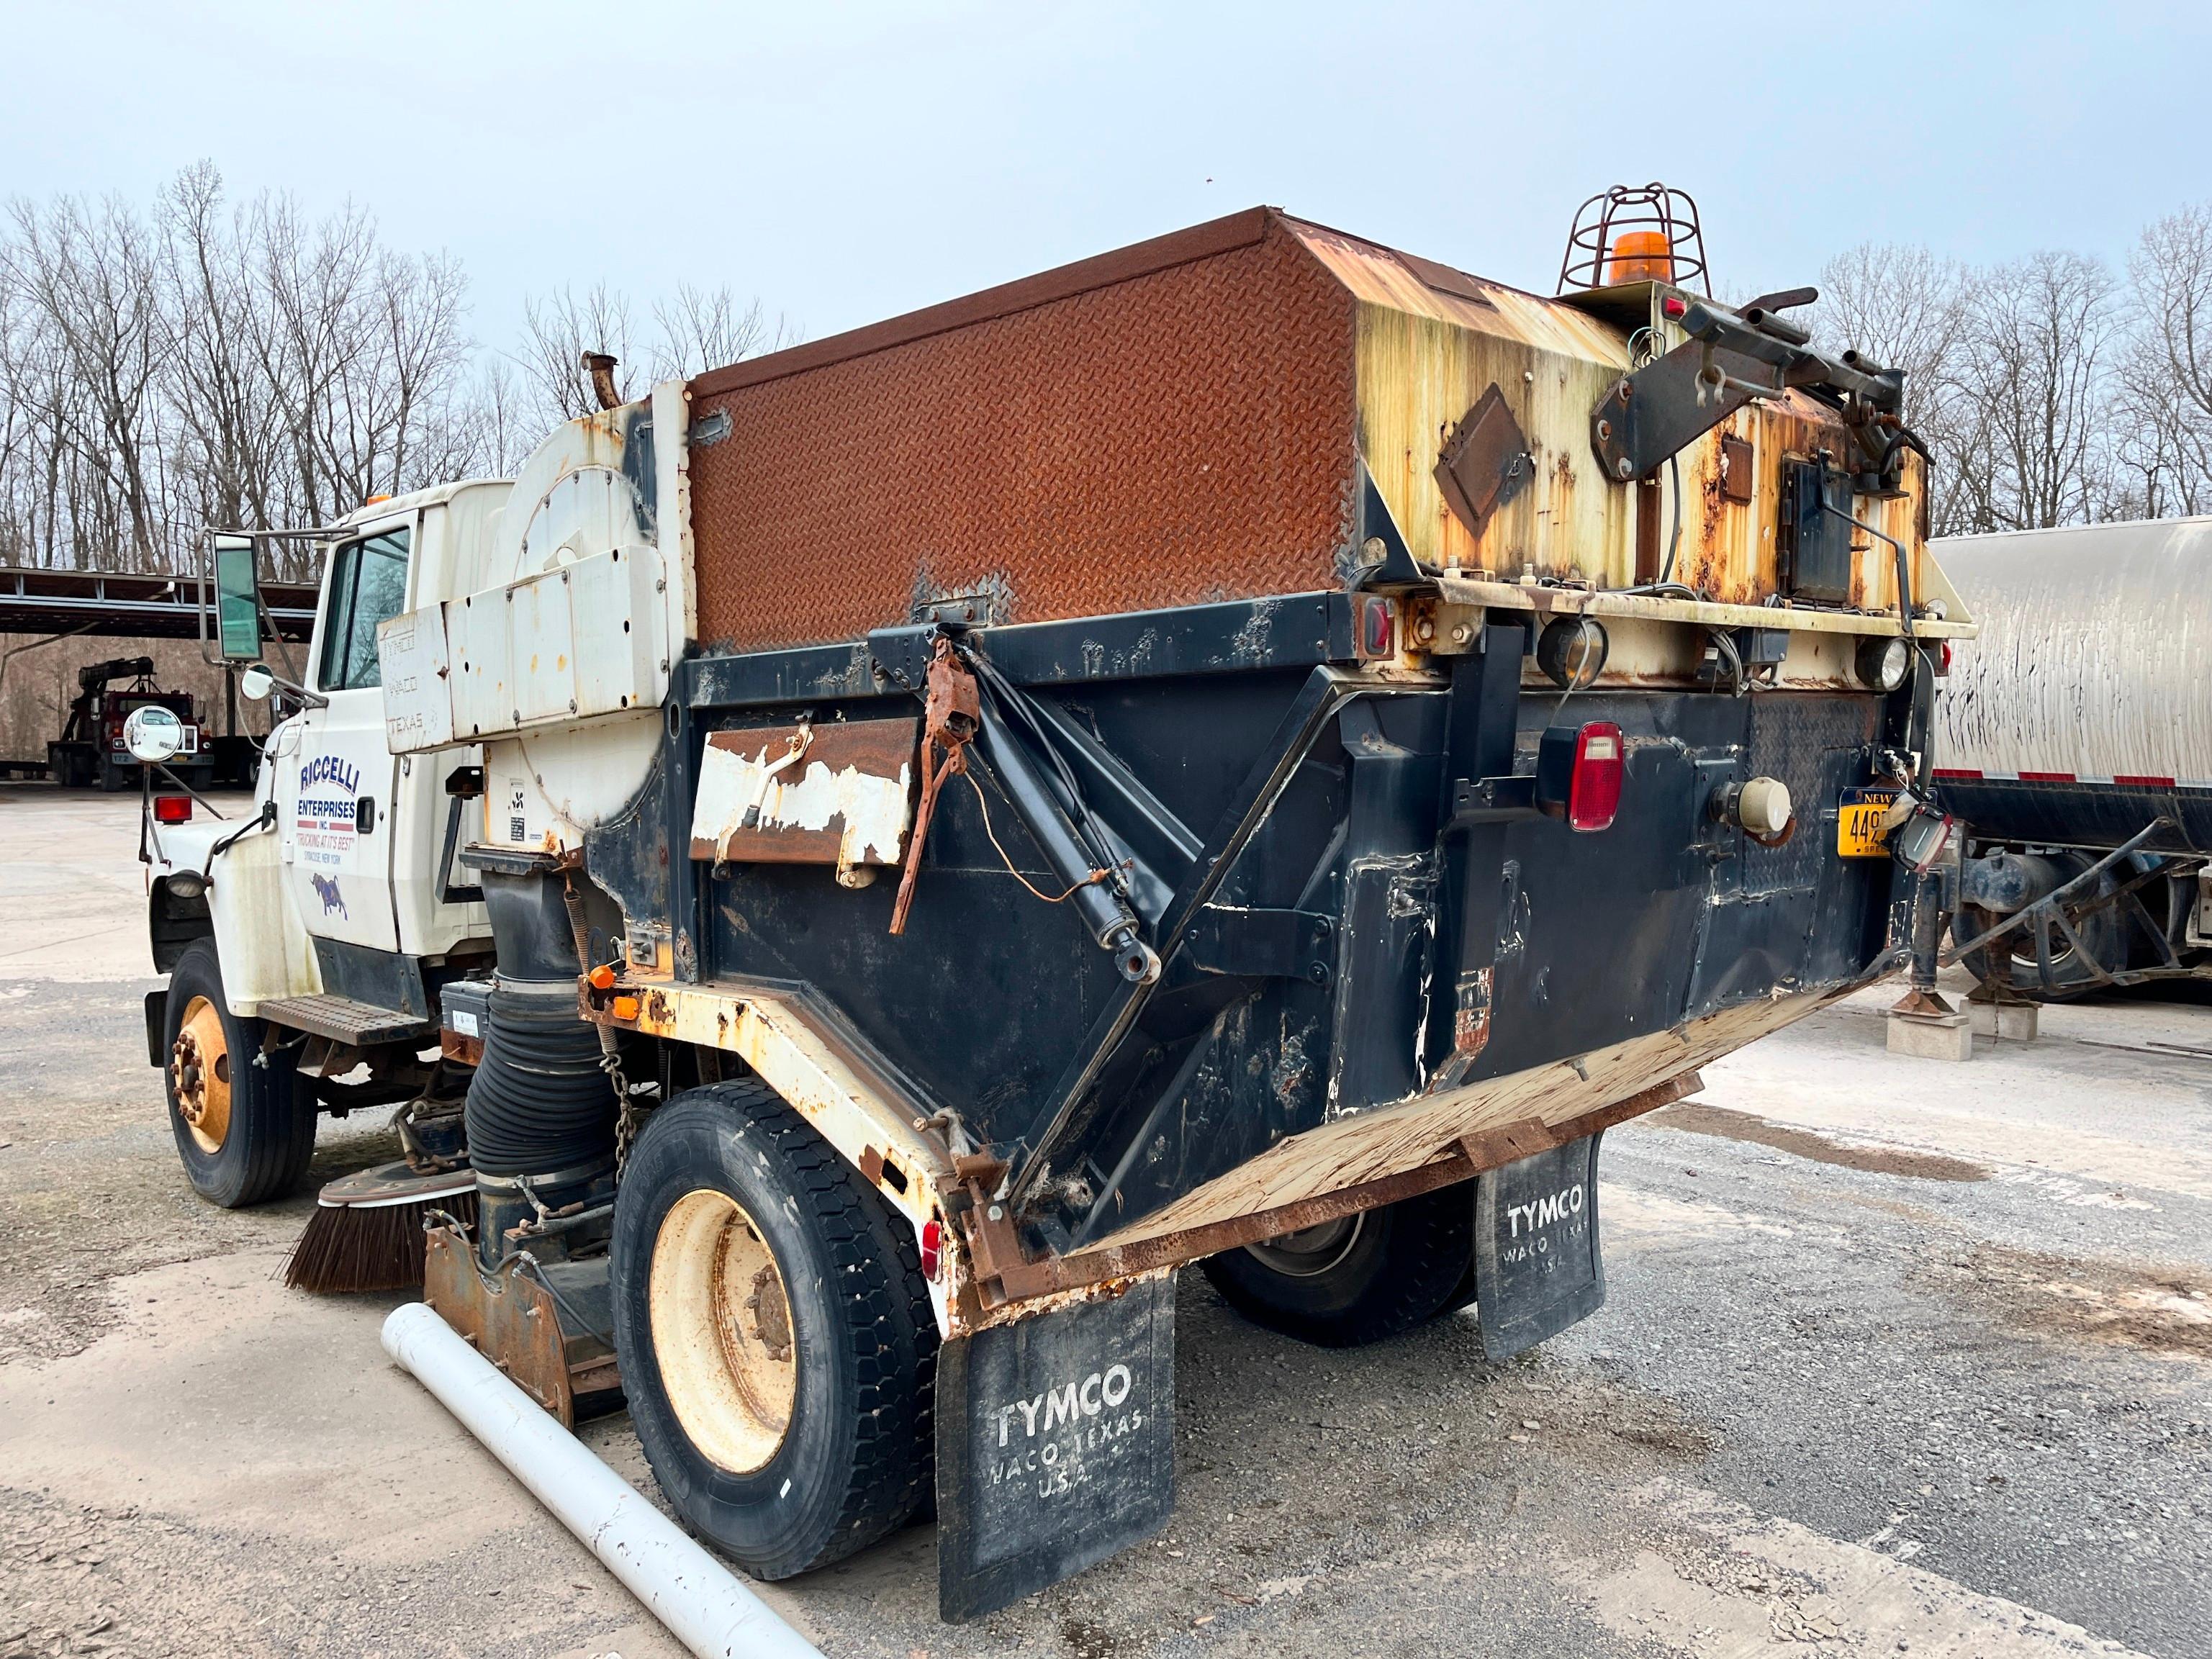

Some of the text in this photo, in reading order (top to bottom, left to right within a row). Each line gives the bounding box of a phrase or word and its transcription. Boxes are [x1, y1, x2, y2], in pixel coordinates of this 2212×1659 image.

[300, 756, 360, 796] RICCELLI
[297, 800, 355, 818] ENTERPRISES
[1864, 794, 1893, 803] NEW
[319, 821, 328, 830] INC.
[320, 835, 328, 848] AT
[1507, 1184, 1582, 1238] TYMCO
[1502, 1237, 1547, 1263] WACO
[990, 1364, 1132, 1447] TYMCO
[982, 1409, 1142, 1488] WACO TEXAS
